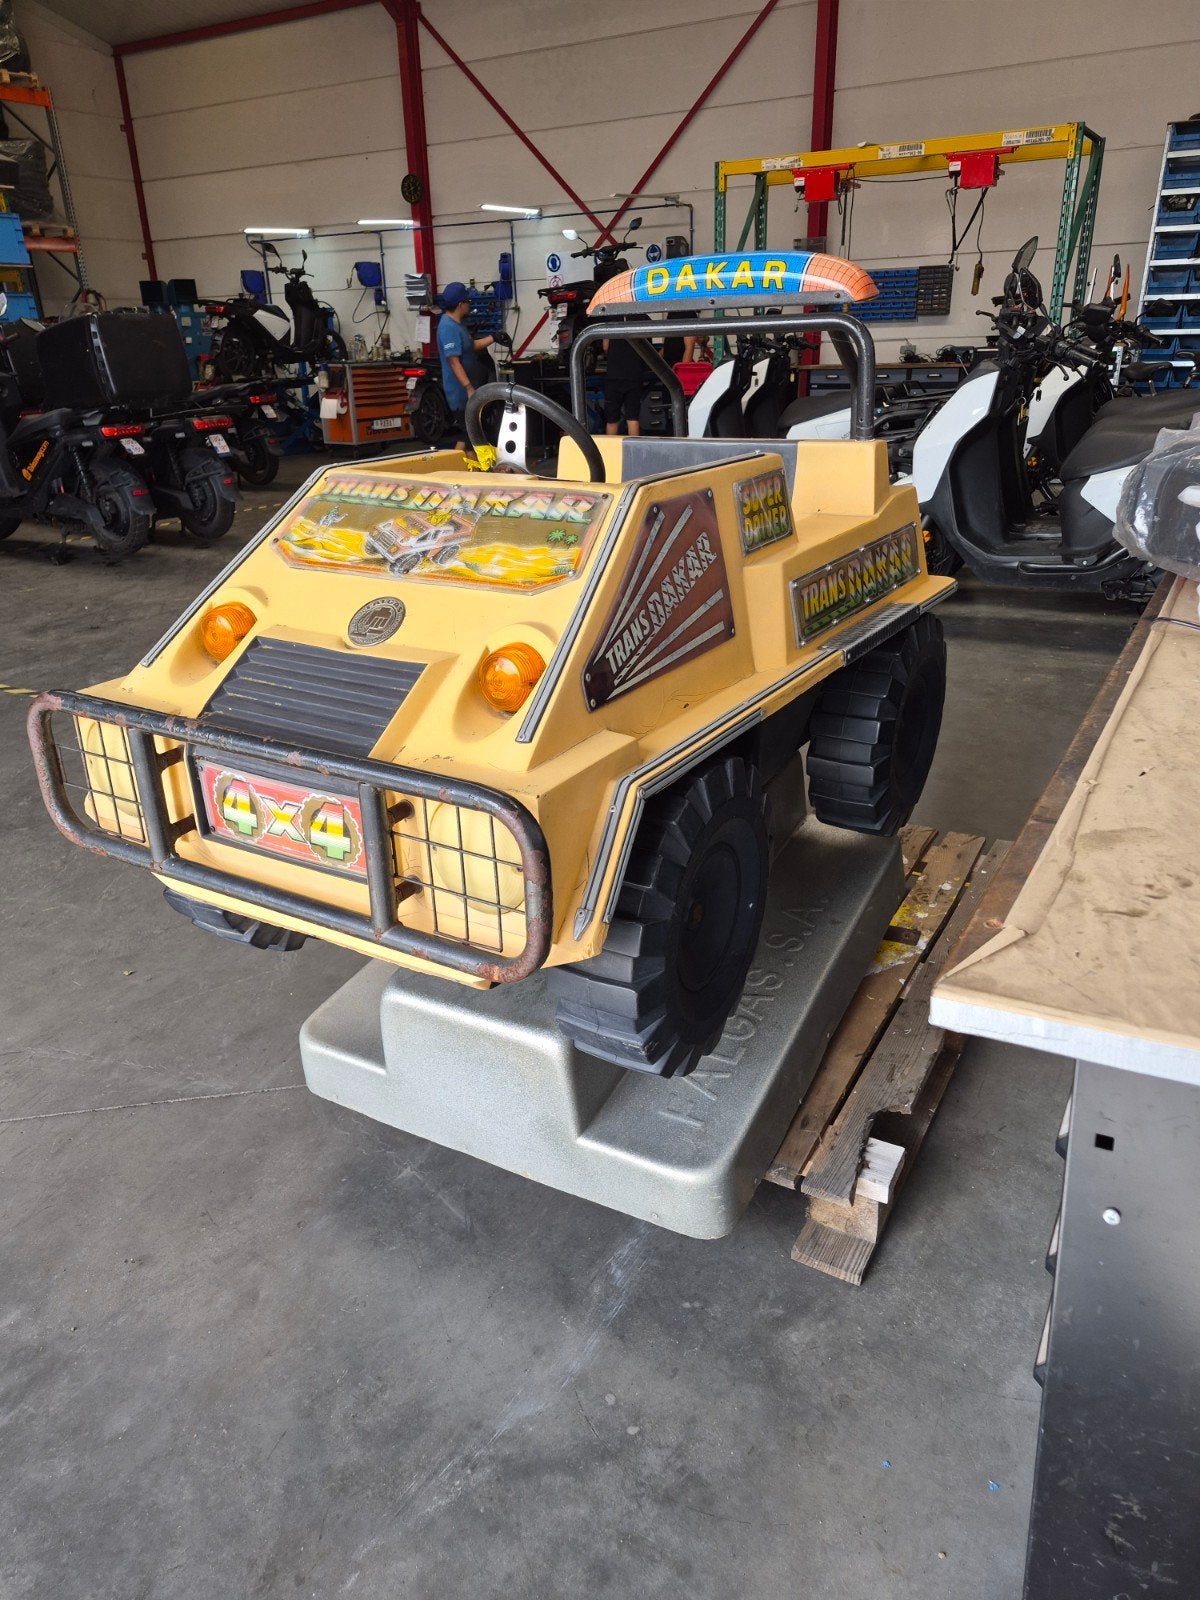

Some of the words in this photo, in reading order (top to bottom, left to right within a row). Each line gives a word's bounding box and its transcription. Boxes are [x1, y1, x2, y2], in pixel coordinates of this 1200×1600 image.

[646, 259, 787, 295] DAKAR
[322, 476, 412, 502] TRANS
[411, 485, 598, 524] DAKAR
[742, 476, 784, 514] SUPER
[743, 509, 788, 545] DRIVER
[801, 574, 847, 620] TRANS
[846, 532, 913, 605] DAKAR
[605, 608, 654, 674] TRANS
[647, 531, 717, 633] DAKAR
